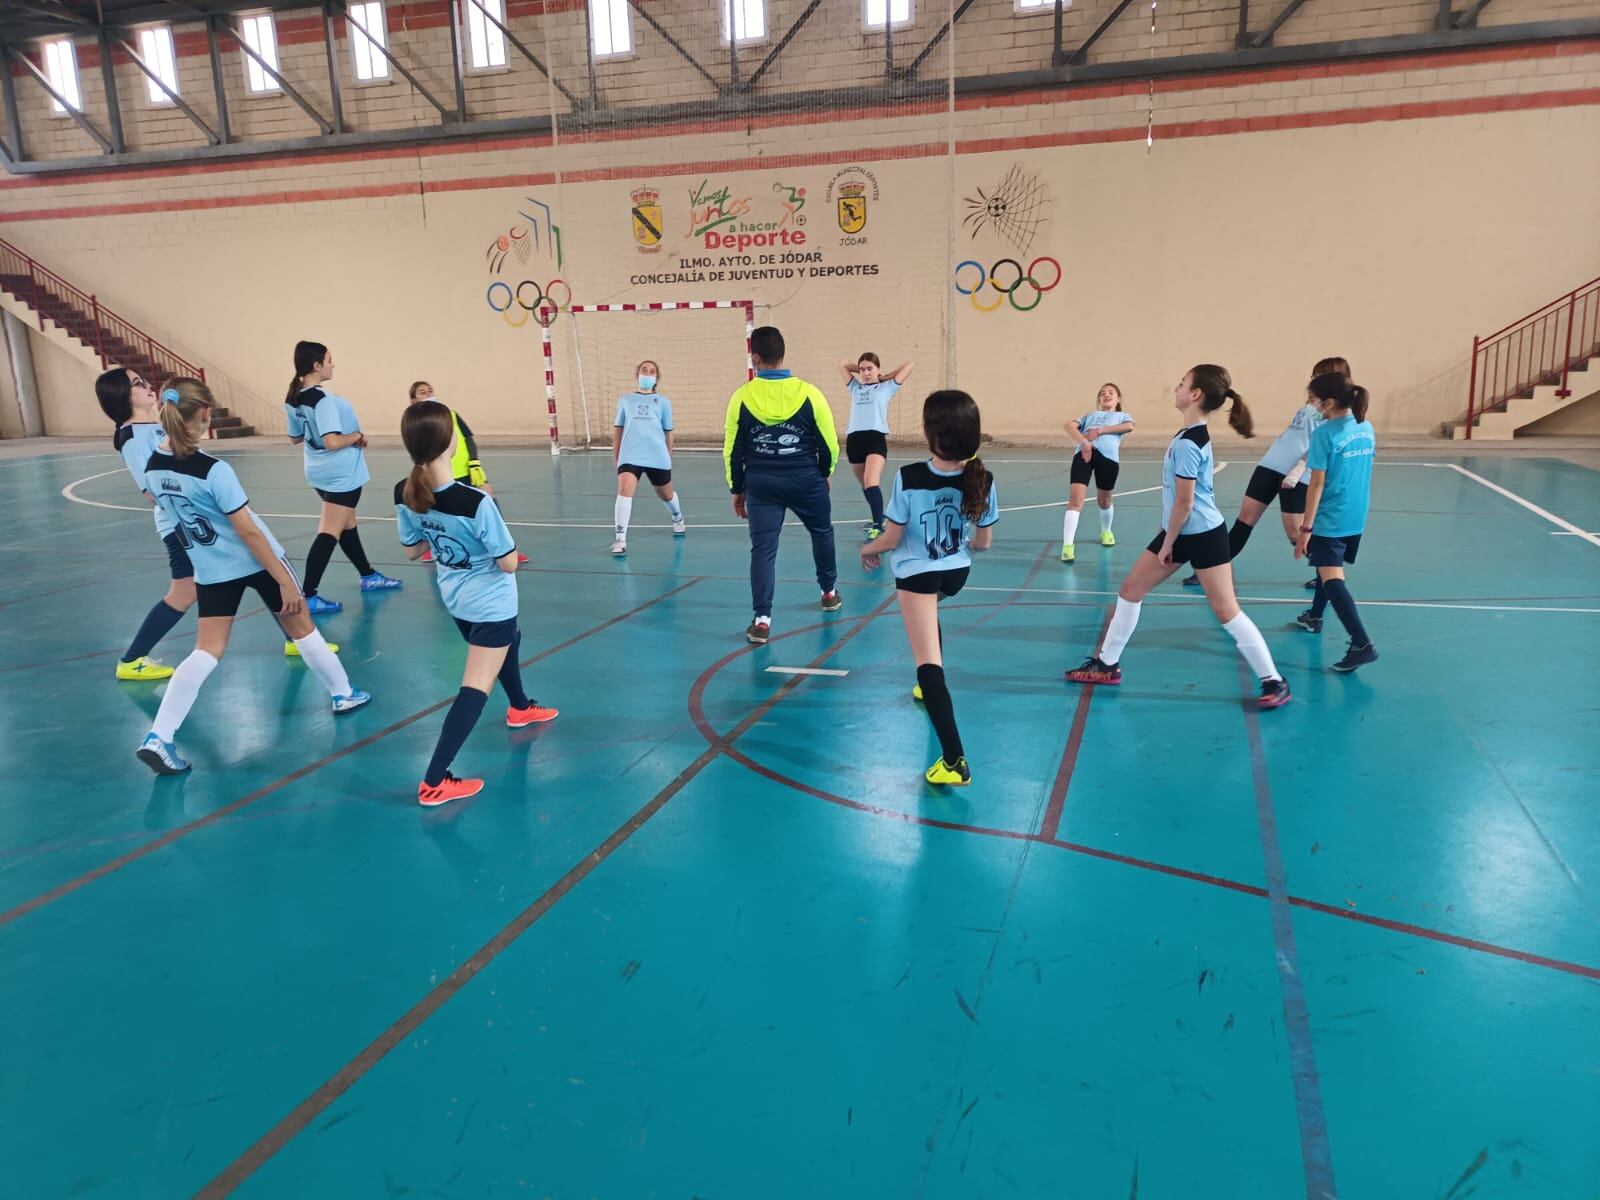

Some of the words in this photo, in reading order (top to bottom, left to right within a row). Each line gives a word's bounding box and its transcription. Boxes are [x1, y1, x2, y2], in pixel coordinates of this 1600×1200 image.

[740, 222, 778, 232] hacer
[704, 228, 806, 252] Deporte
[839, 236, 867, 246] JÓDAR
[680, 257, 715, 269] ILMO.
[719, 255, 756, 267] AYTO.
[759, 255, 775, 264] DE
[779, 250, 823, 264] JÓDAR
[630, 269, 705, 285] CONCEJALÍA
[709, 271, 725, 282] DE
[728, 268, 794, 281] JUVENTUD
[797, 267, 806, 278] Y
[810, 264, 879, 277] DEPORTES
[158, 492, 219, 550] 15
[919, 504, 964, 560] 10
